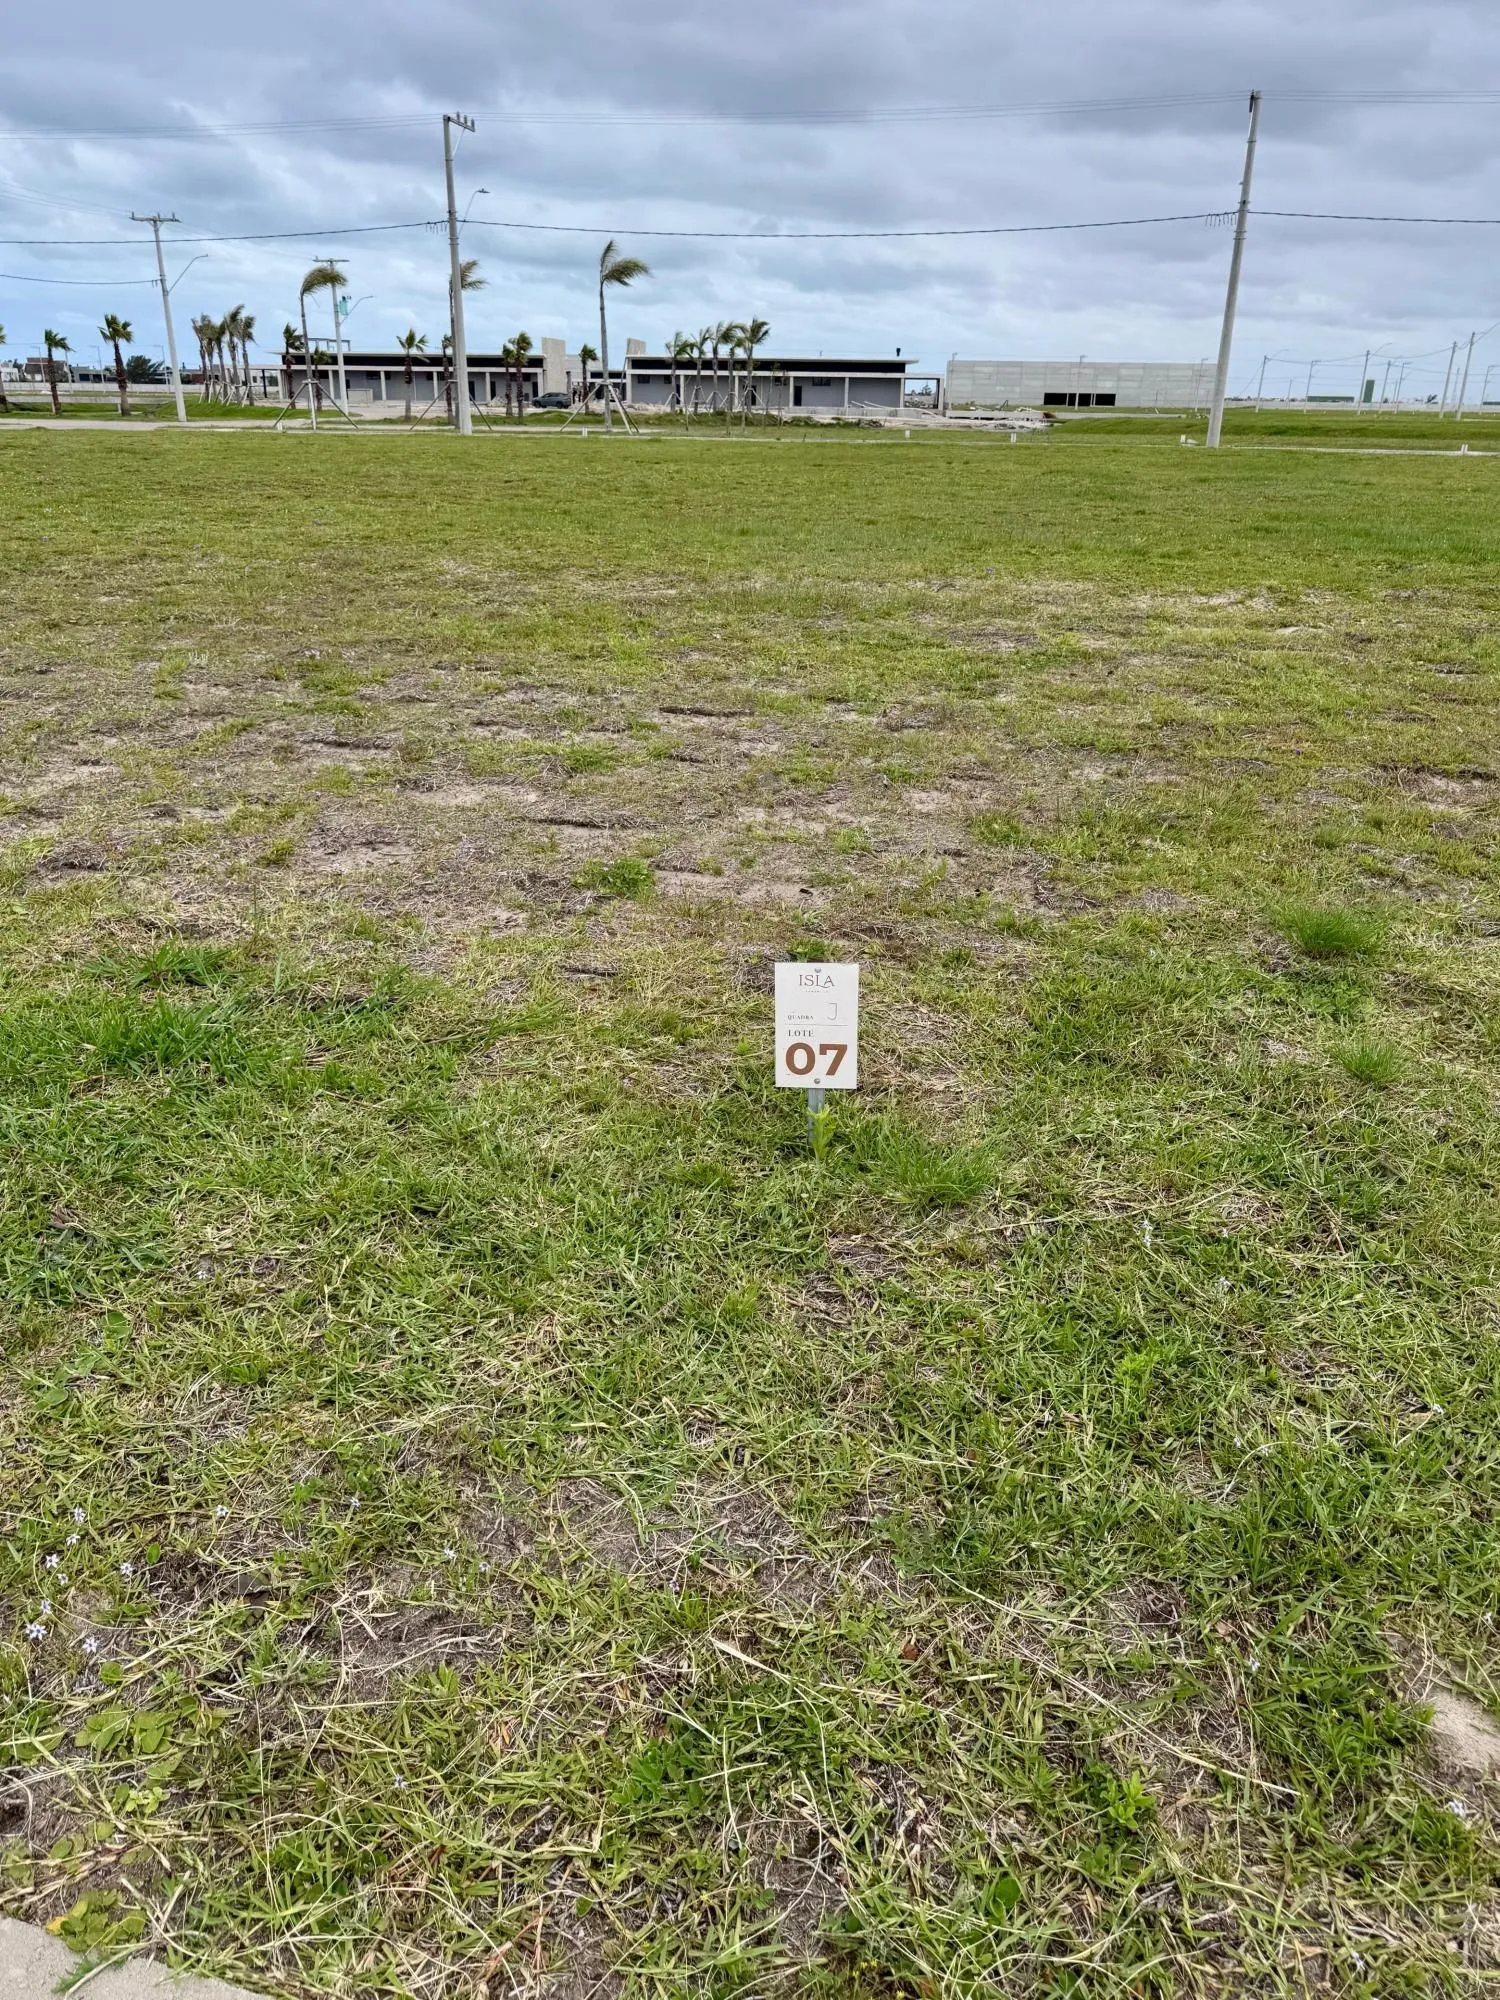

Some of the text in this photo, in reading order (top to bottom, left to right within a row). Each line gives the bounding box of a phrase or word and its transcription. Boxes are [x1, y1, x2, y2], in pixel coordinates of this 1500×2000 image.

[799, 974, 835, 989] ISLA
[827, 1002, 838, 1021] J
[788, 1029, 815, 1037] LOTE
[785, 1042, 848, 1076] 07
